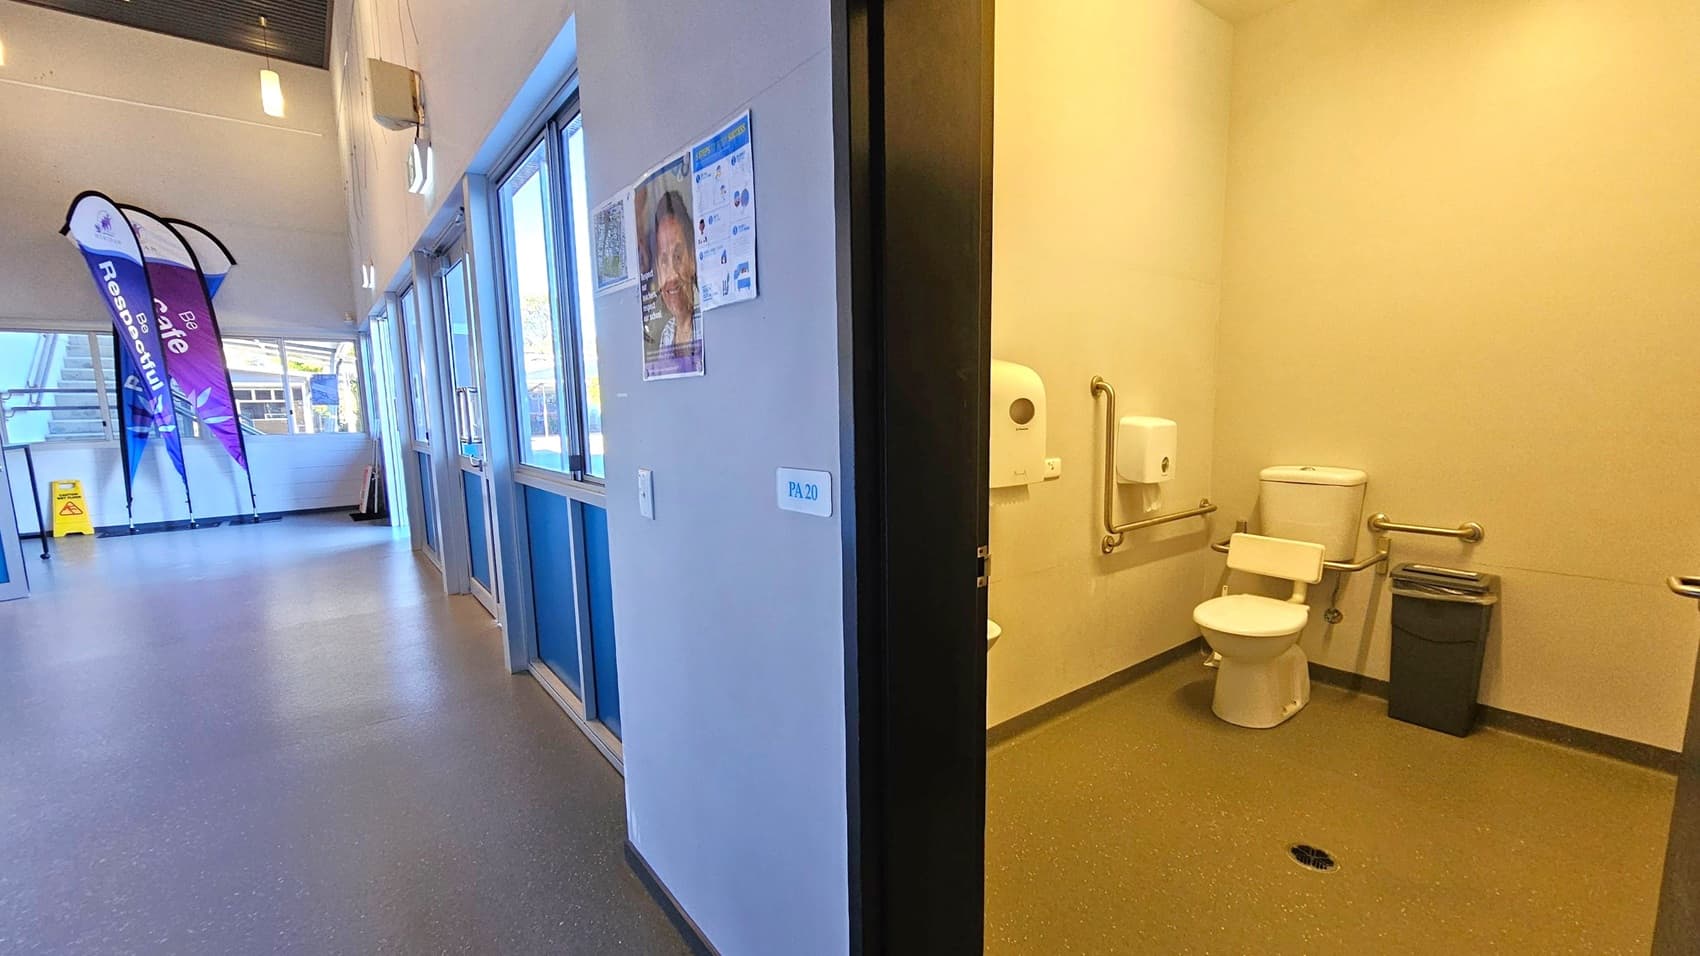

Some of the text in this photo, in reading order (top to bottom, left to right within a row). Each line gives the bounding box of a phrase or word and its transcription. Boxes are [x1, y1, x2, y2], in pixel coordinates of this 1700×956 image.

[98, 260, 164, 391] Respectful
[135, 312, 149, 334] Be
[178, 310, 198, 331] Be
[789, 481, 818, 501] PA 20
